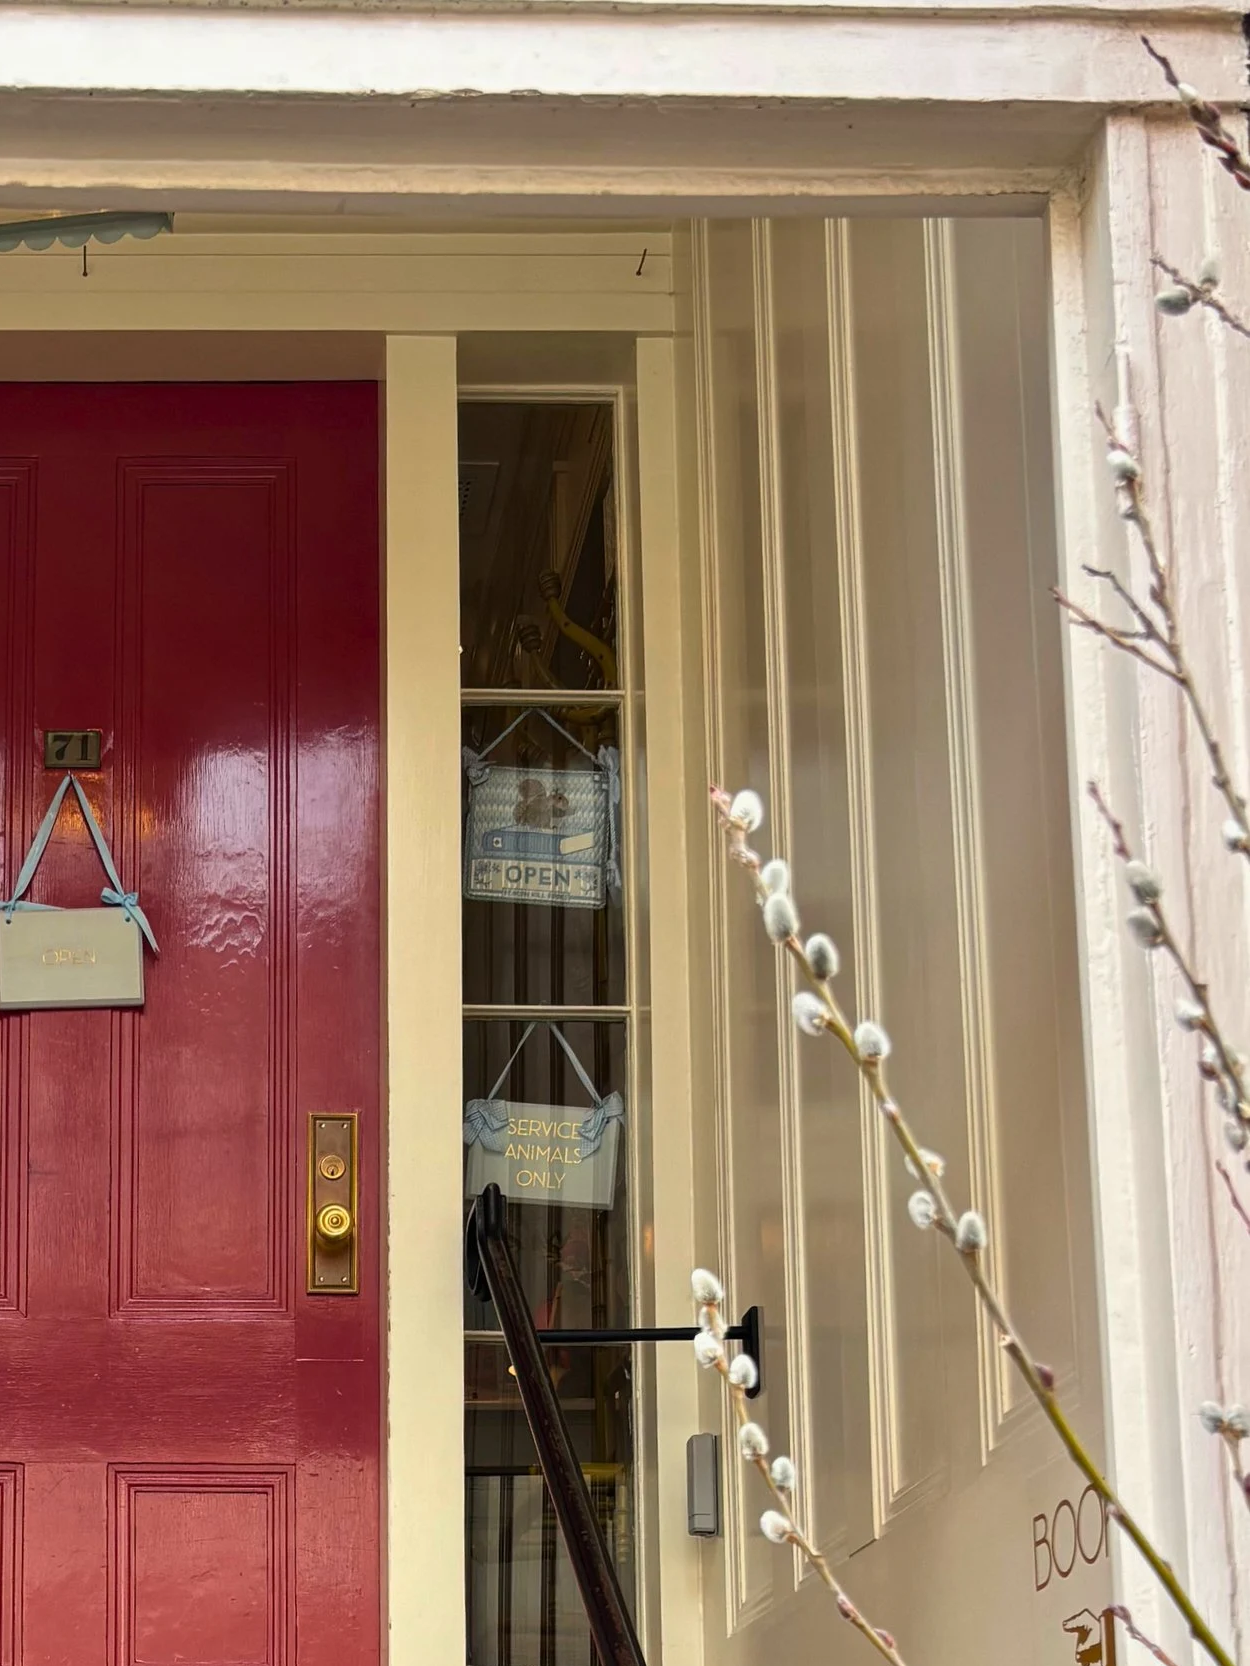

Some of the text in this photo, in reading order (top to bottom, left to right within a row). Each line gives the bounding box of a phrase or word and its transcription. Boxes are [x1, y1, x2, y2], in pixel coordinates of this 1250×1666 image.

[51, 734, 93, 762] 71
[506, 865, 570, 887] OPEN
[507, 1118, 584, 1140] SERVICE
[504, 1143, 582, 1164] ANIMALS
[516, 1169, 566, 1189] ONLY
[1033, 1482, 1109, 1592] BOO
